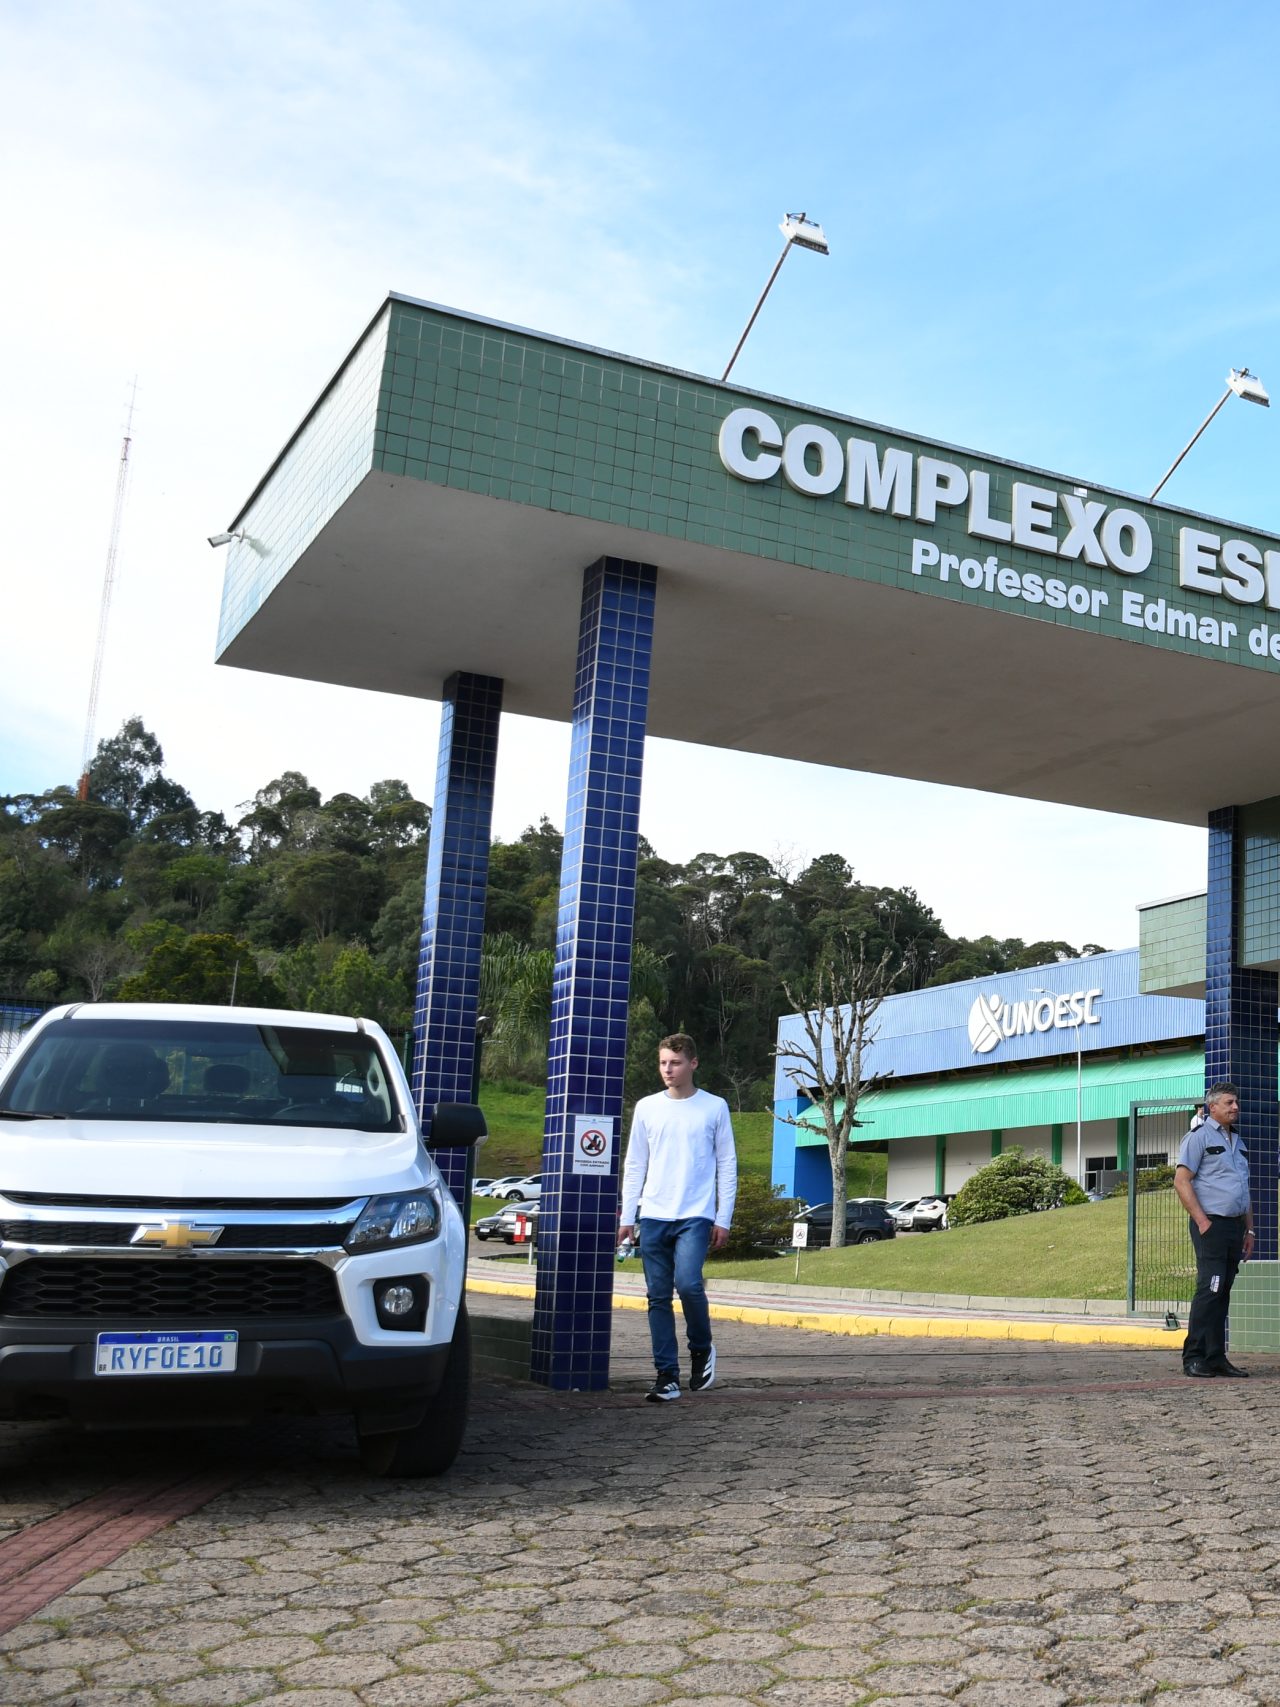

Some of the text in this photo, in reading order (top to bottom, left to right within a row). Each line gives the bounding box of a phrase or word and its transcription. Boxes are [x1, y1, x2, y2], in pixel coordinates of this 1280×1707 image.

[719, 407, 1153, 576] COMPLEXO
[911, 539, 1109, 618] Professor
[1121, 590, 1238, 649] Edmar
[1002, 988, 1102, 1037] UNOESC
